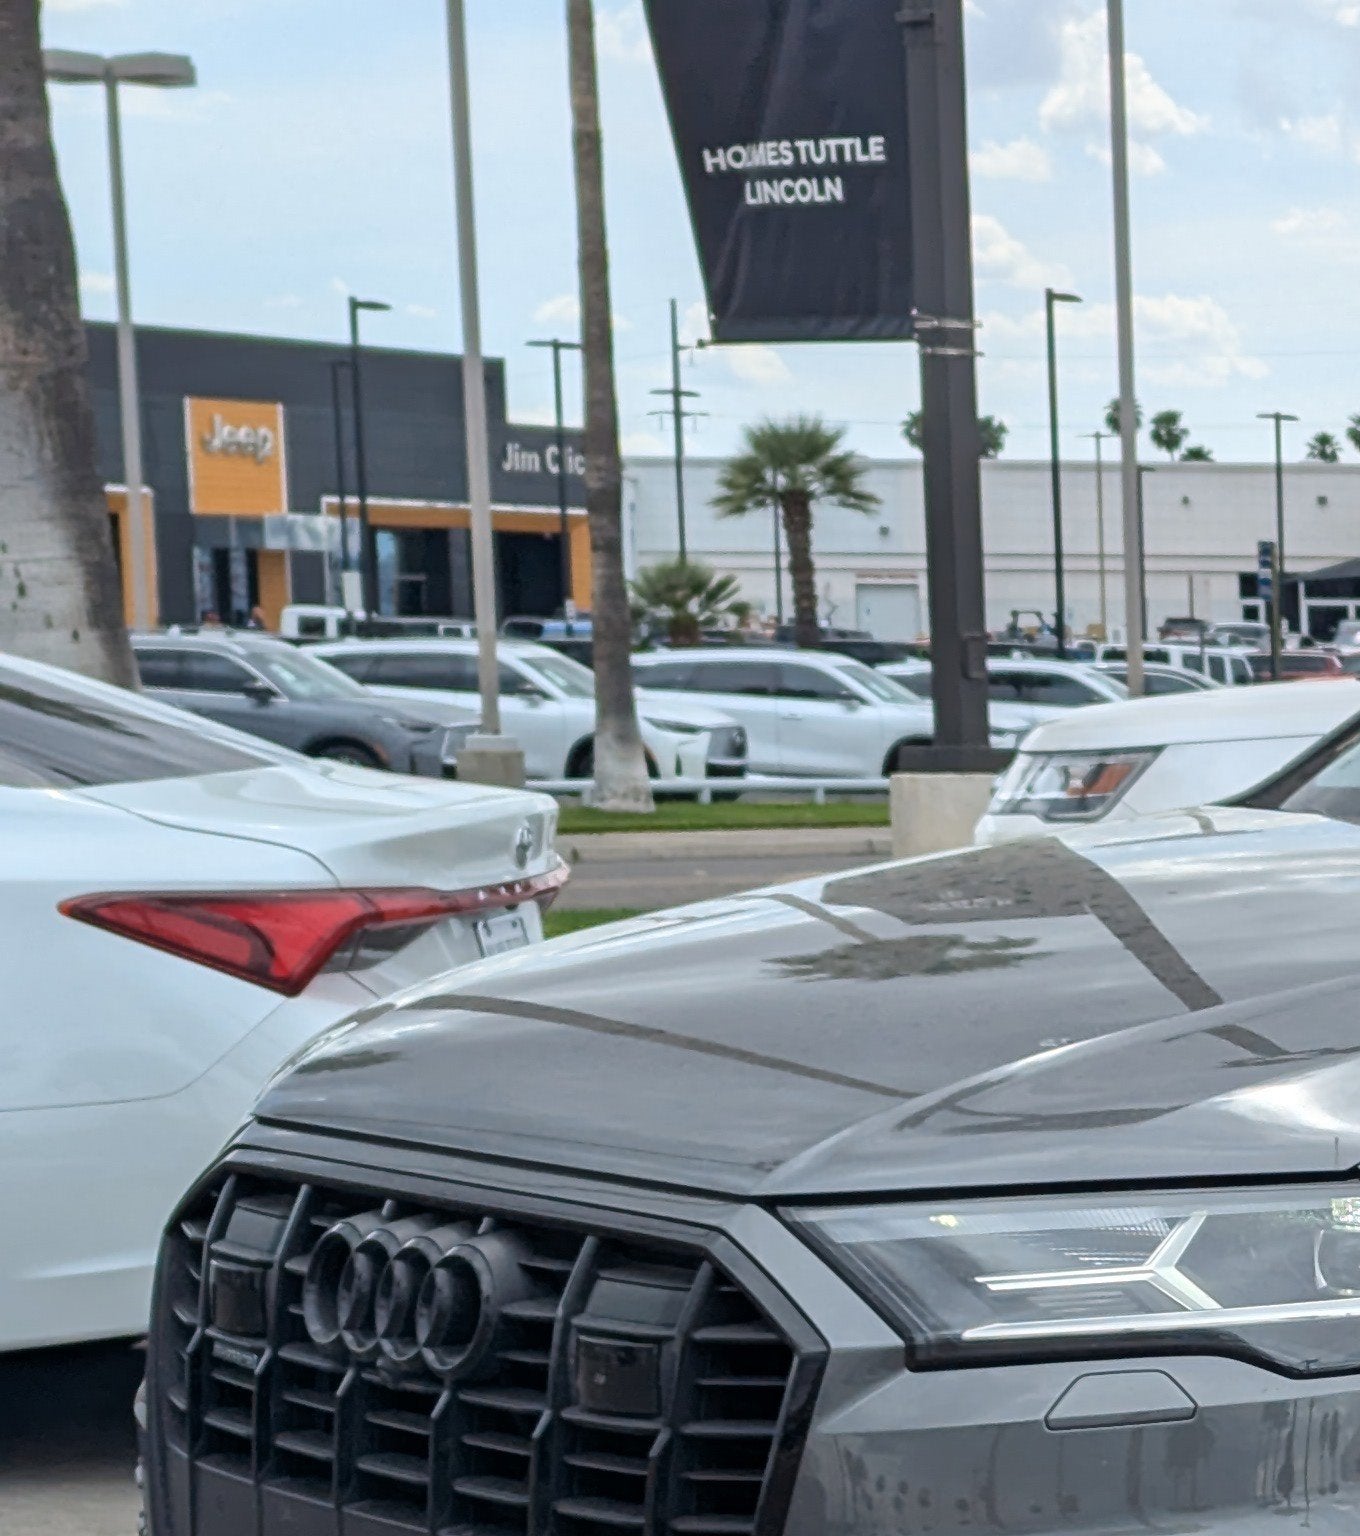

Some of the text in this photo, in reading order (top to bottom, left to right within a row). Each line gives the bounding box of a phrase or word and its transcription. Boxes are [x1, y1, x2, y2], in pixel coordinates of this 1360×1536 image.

[795, 135, 887, 166] TUTTLE
[744, 176, 844, 205] LINCOLN
[202, 413, 273, 463] Jeep
[502, 442, 540, 472] Jim
